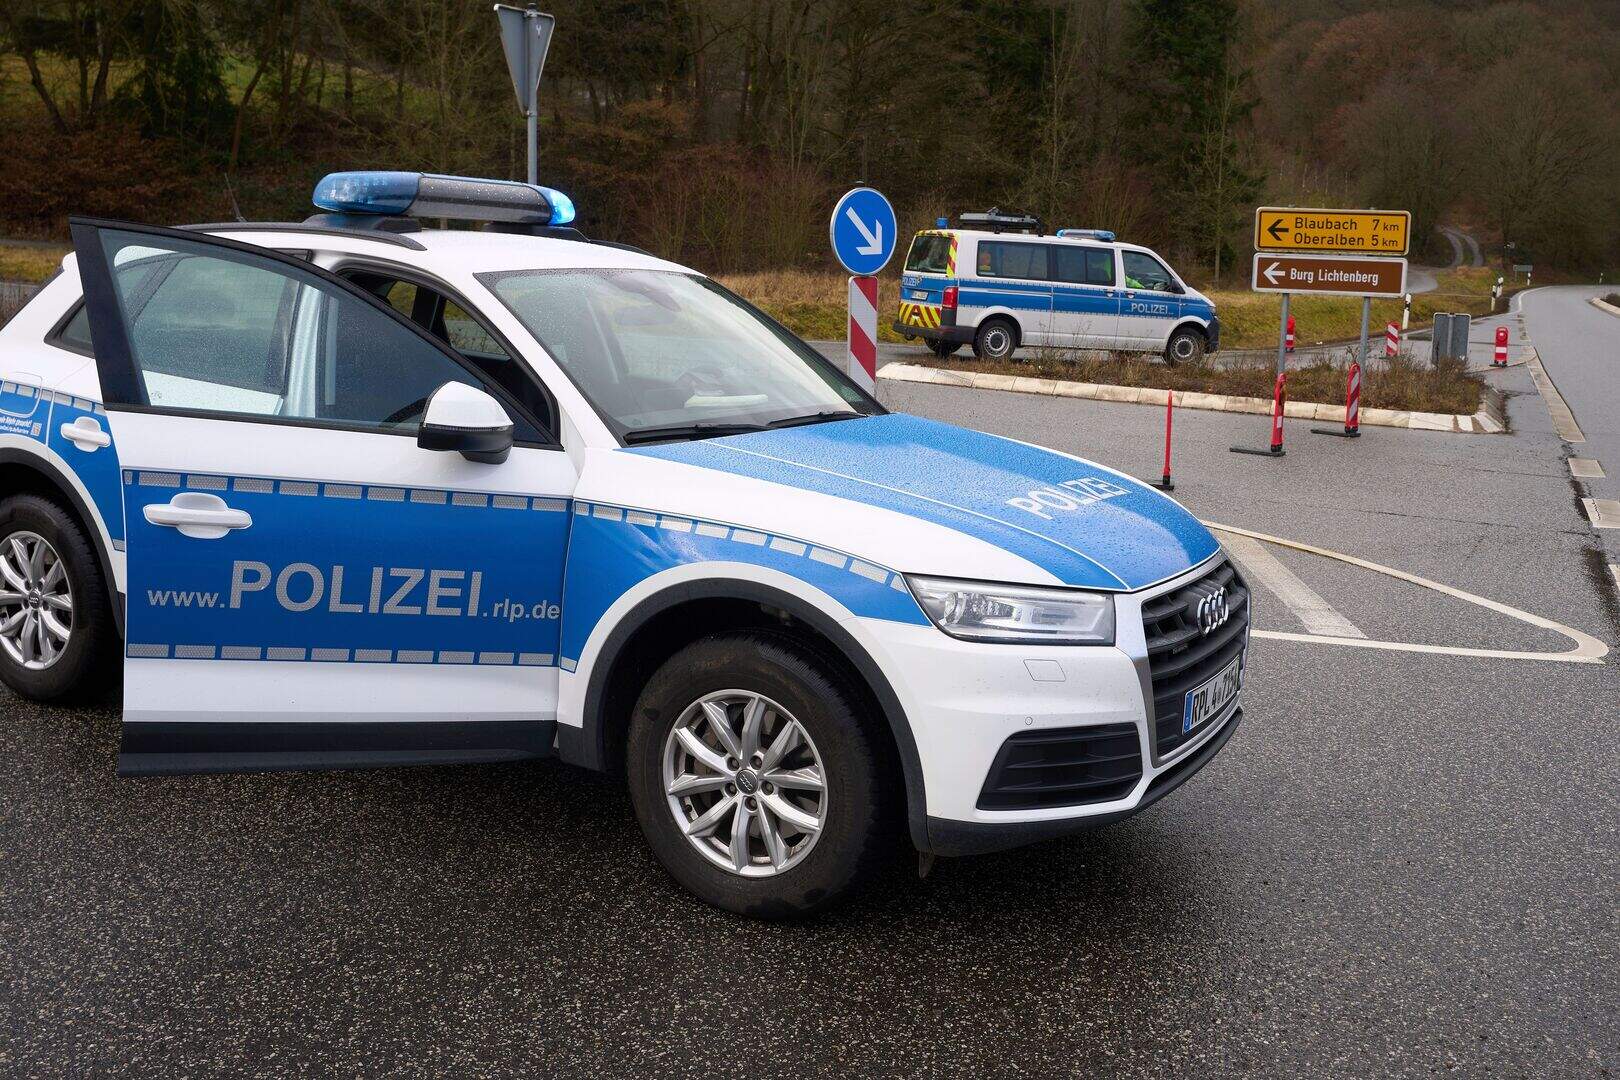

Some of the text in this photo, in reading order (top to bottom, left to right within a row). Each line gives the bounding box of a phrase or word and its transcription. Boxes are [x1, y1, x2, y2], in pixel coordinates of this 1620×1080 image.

[1294, 217, 1400, 232] Blaubach 7 km
[1293, 232, 1398, 247] Oberalben 5 km
[1290, 268, 1379, 286] Burg Lichtenberg
[1131, 303, 1168, 314] POLIZEI
[1005, 476, 1133, 520] POLIZEI
[1192, 687, 1210, 725] RPL
